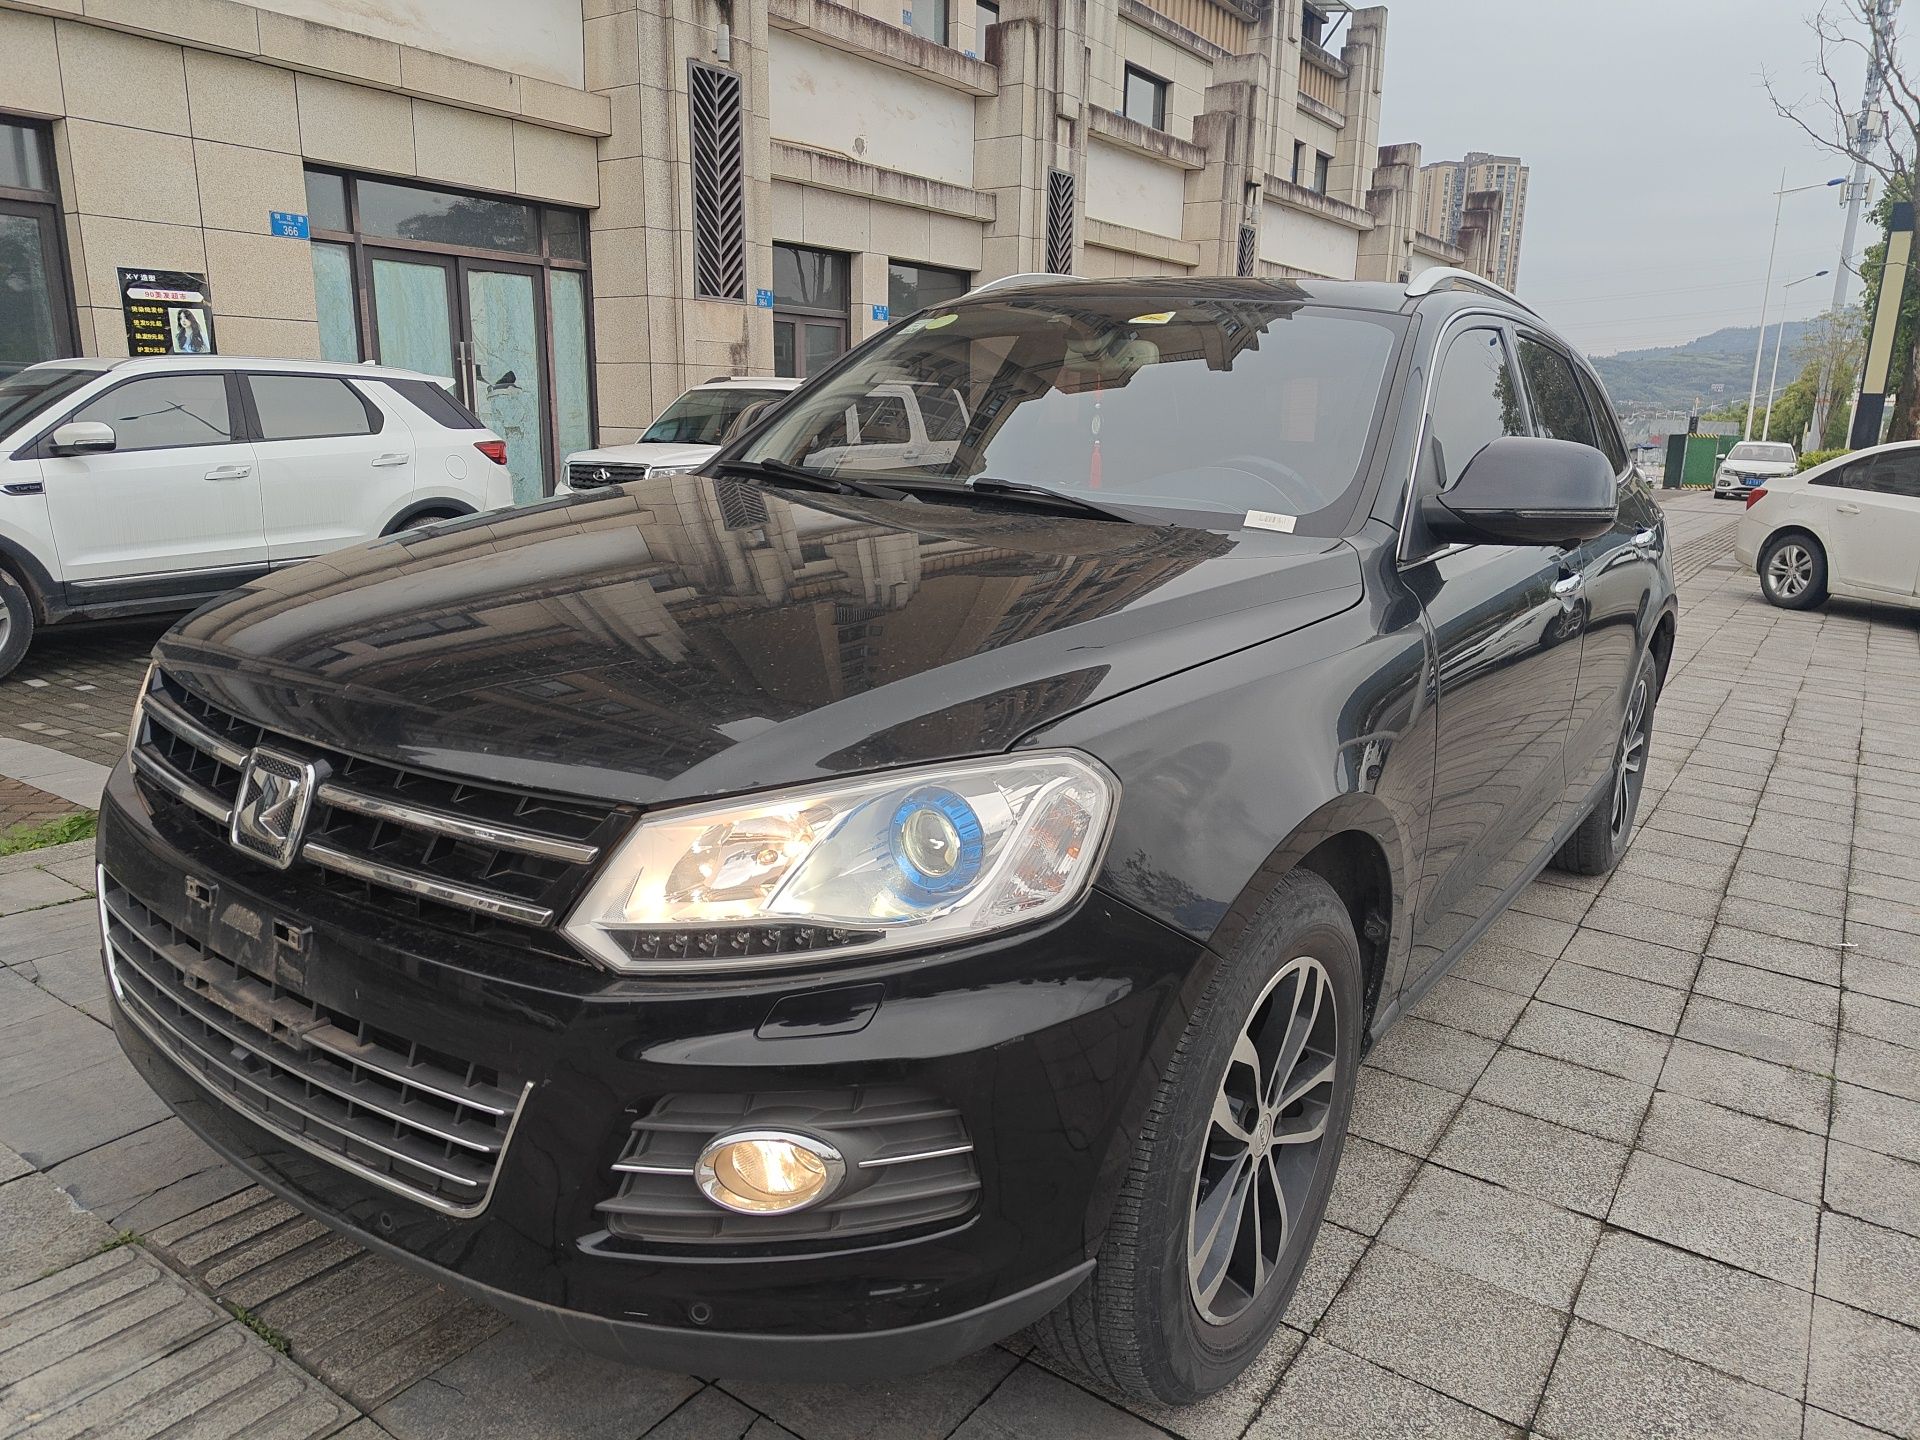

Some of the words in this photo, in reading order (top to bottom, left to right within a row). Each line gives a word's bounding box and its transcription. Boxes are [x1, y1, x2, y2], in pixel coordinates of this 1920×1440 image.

[282, 225, 299, 236] 366
[144, 291, 187, 300] 90美发超市
